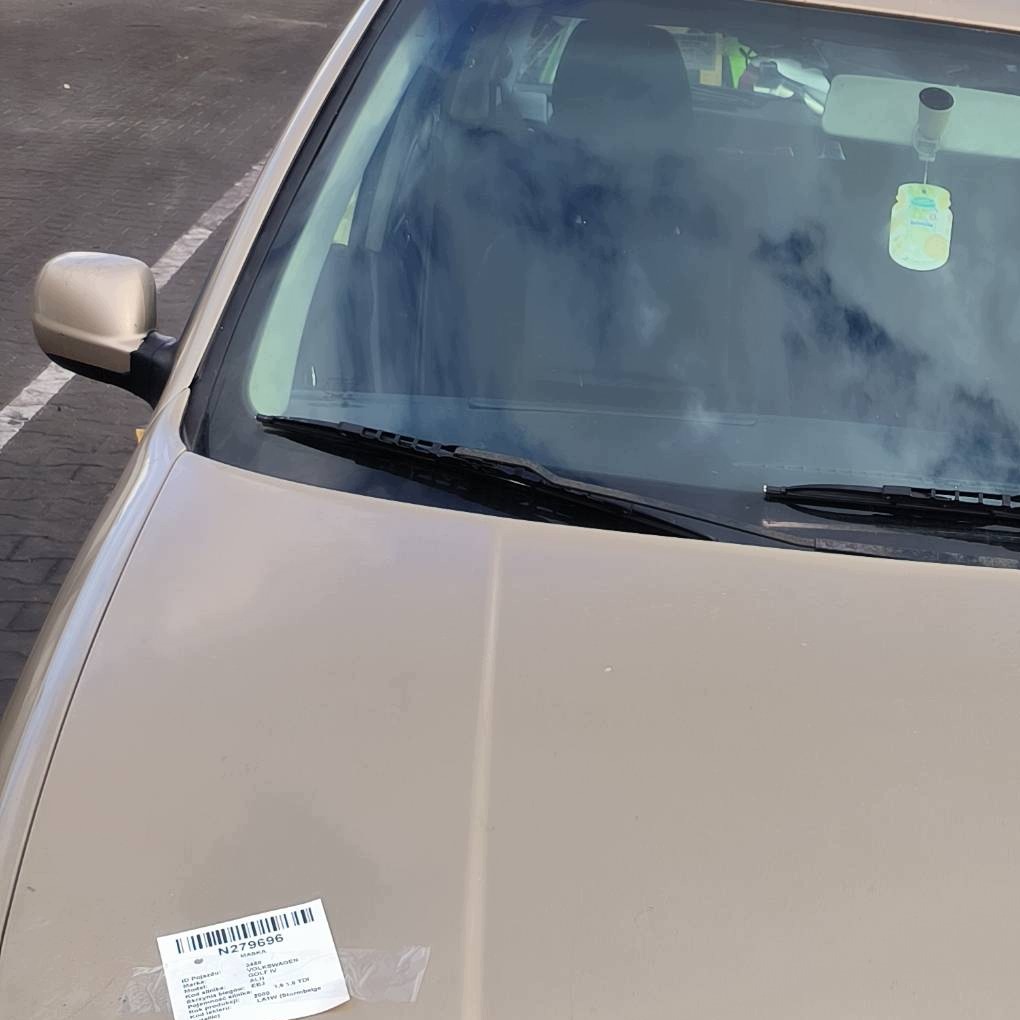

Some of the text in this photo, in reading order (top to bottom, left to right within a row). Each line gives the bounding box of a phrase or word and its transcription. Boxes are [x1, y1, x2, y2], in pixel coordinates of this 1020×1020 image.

[218, 934, 284, 956] N279696
[246, 958, 299, 973] VOLKSWAGEN
[248, 970, 268, 978] GOLF
